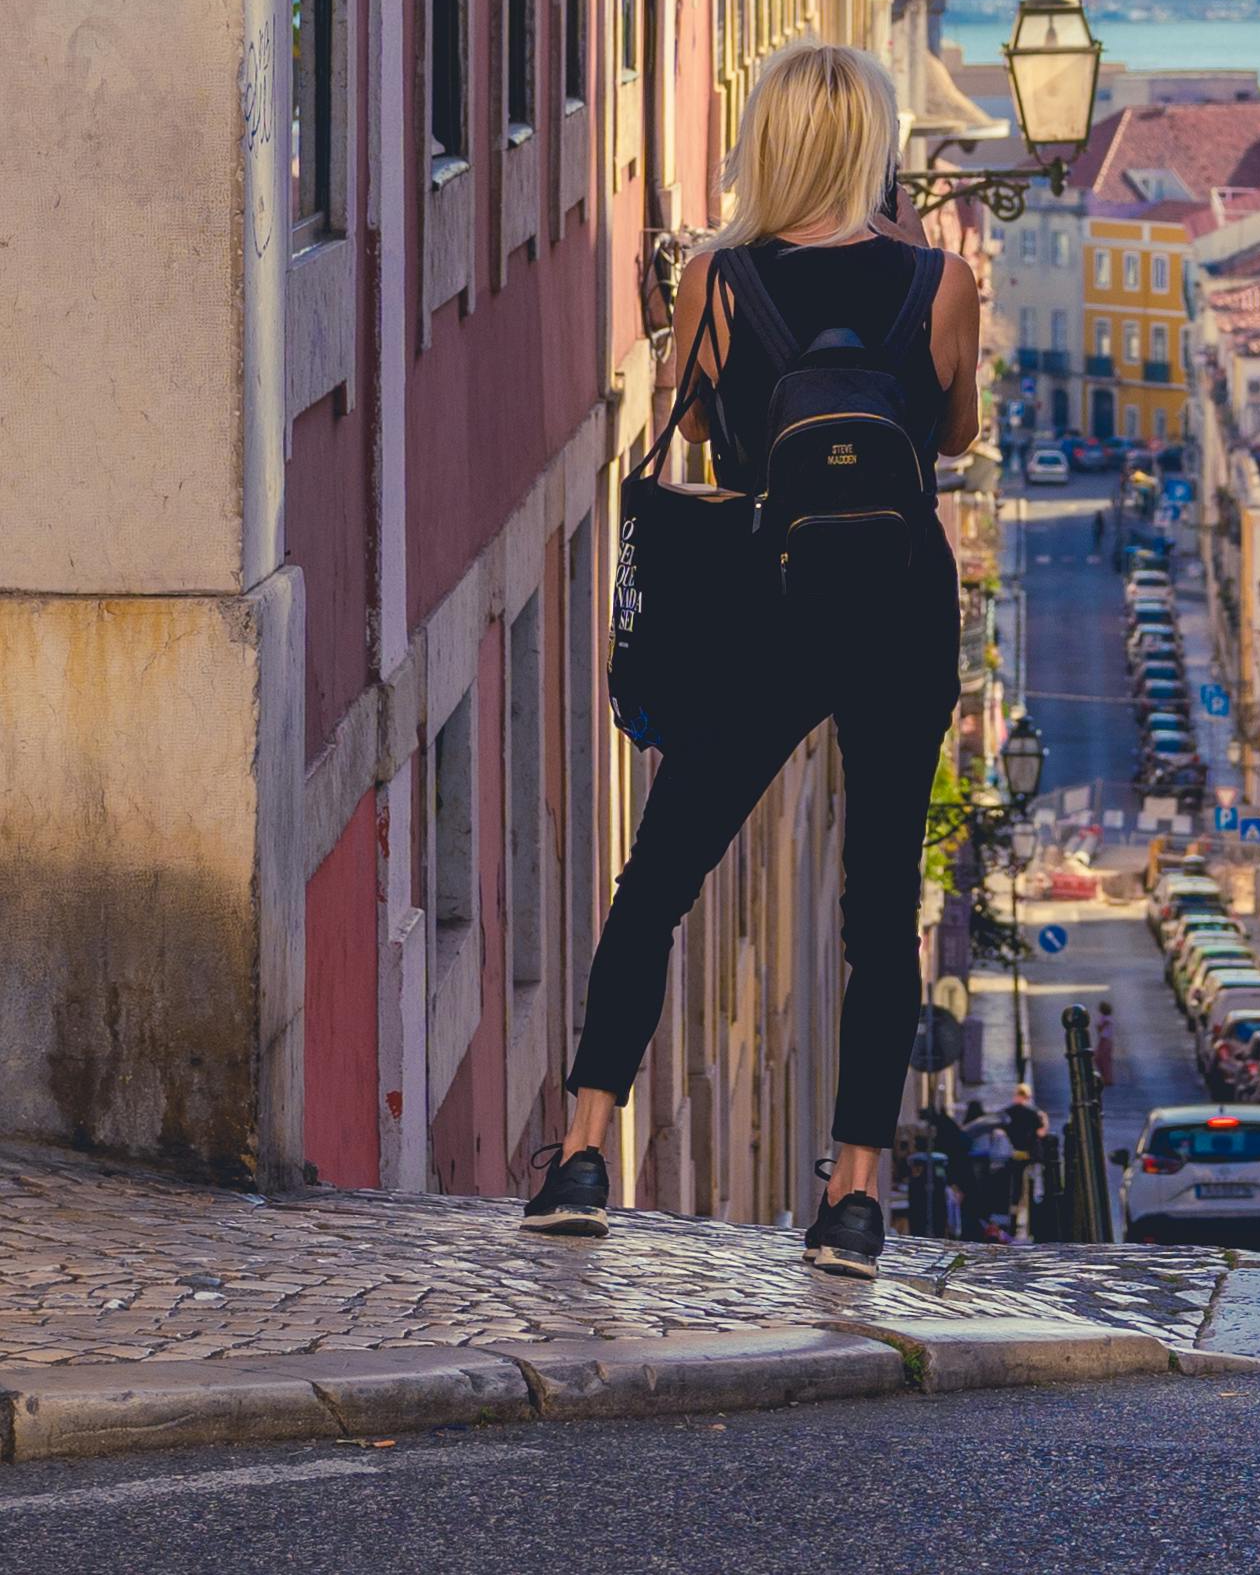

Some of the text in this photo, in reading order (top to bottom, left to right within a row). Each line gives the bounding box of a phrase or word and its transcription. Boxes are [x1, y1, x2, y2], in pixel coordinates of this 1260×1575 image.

[827, 455, 857, 465] MADDEN
[832, 444, 854, 454] STEVE
[622, 517, 637, 541] Ó
[616, 565, 637, 587] QUE
[617, 586, 642, 614] NADA
[618, 609, 635, 632] SEI
